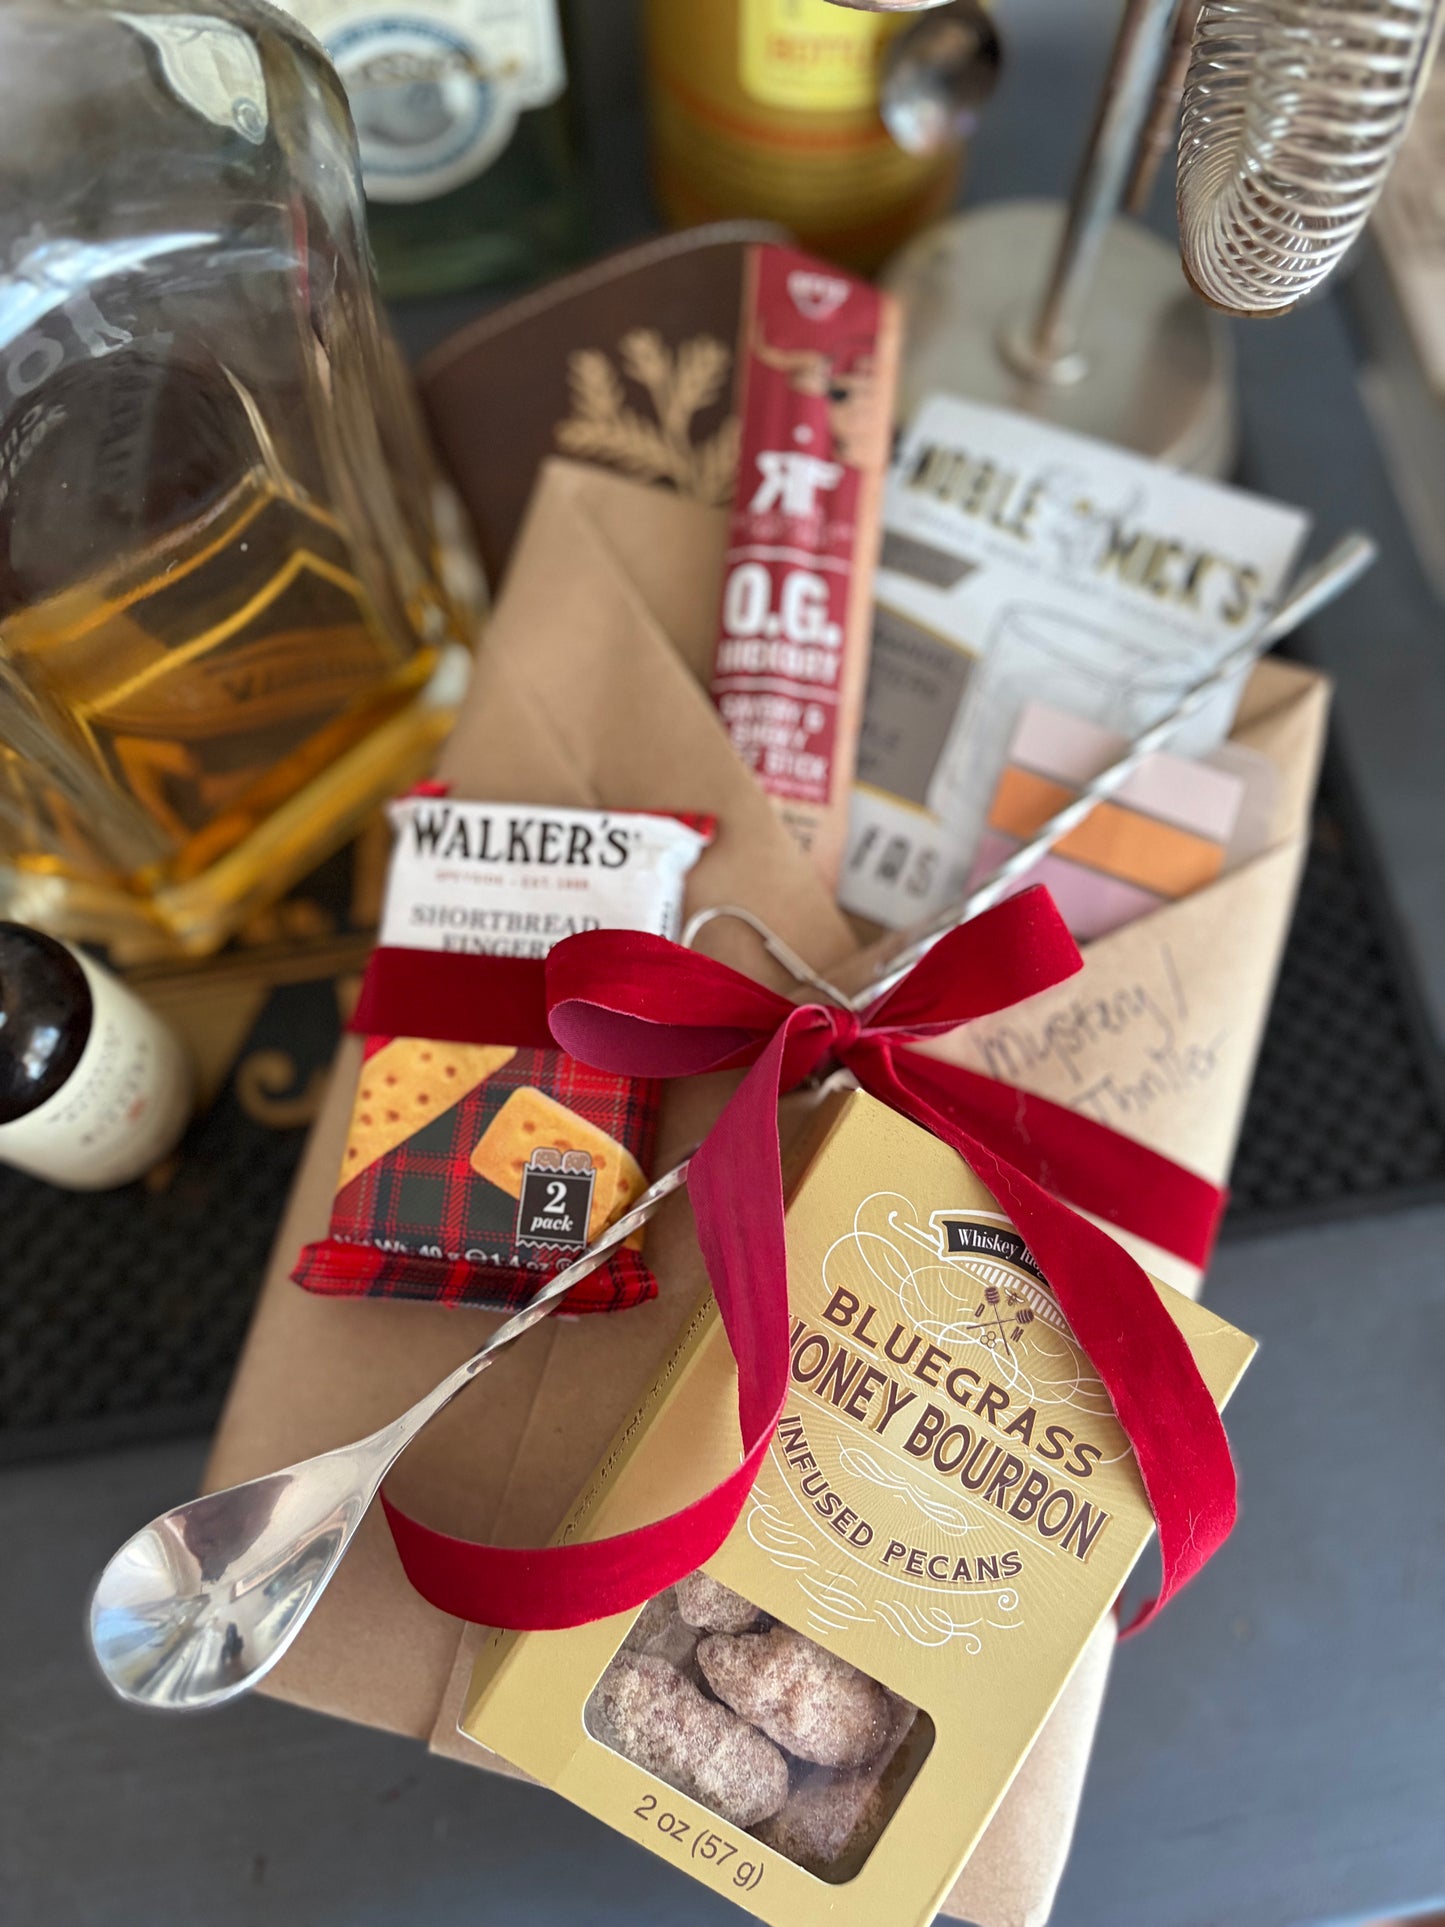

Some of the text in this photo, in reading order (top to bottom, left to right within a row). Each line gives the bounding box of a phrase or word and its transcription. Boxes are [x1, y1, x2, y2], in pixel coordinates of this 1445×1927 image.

[723, 562, 842, 648] O.G.
[412, 806, 630, 869] WALKER'S
[530, 1214, 574, 1233] pack
[543, 1181, 567, 1214] 2
[957, 1227, 1019, 1260] Whiskey
[1009, 1326, 1024, 1343] M
[820, 1284, 1104, 1479] BLUEGRASS
[777, 1414, 1025, 1583] INFUSED PECANS
[902, 1402, 1111, 1563] BOURBON
[633, 1794, 765, 1892] 2 oz (57 g)
